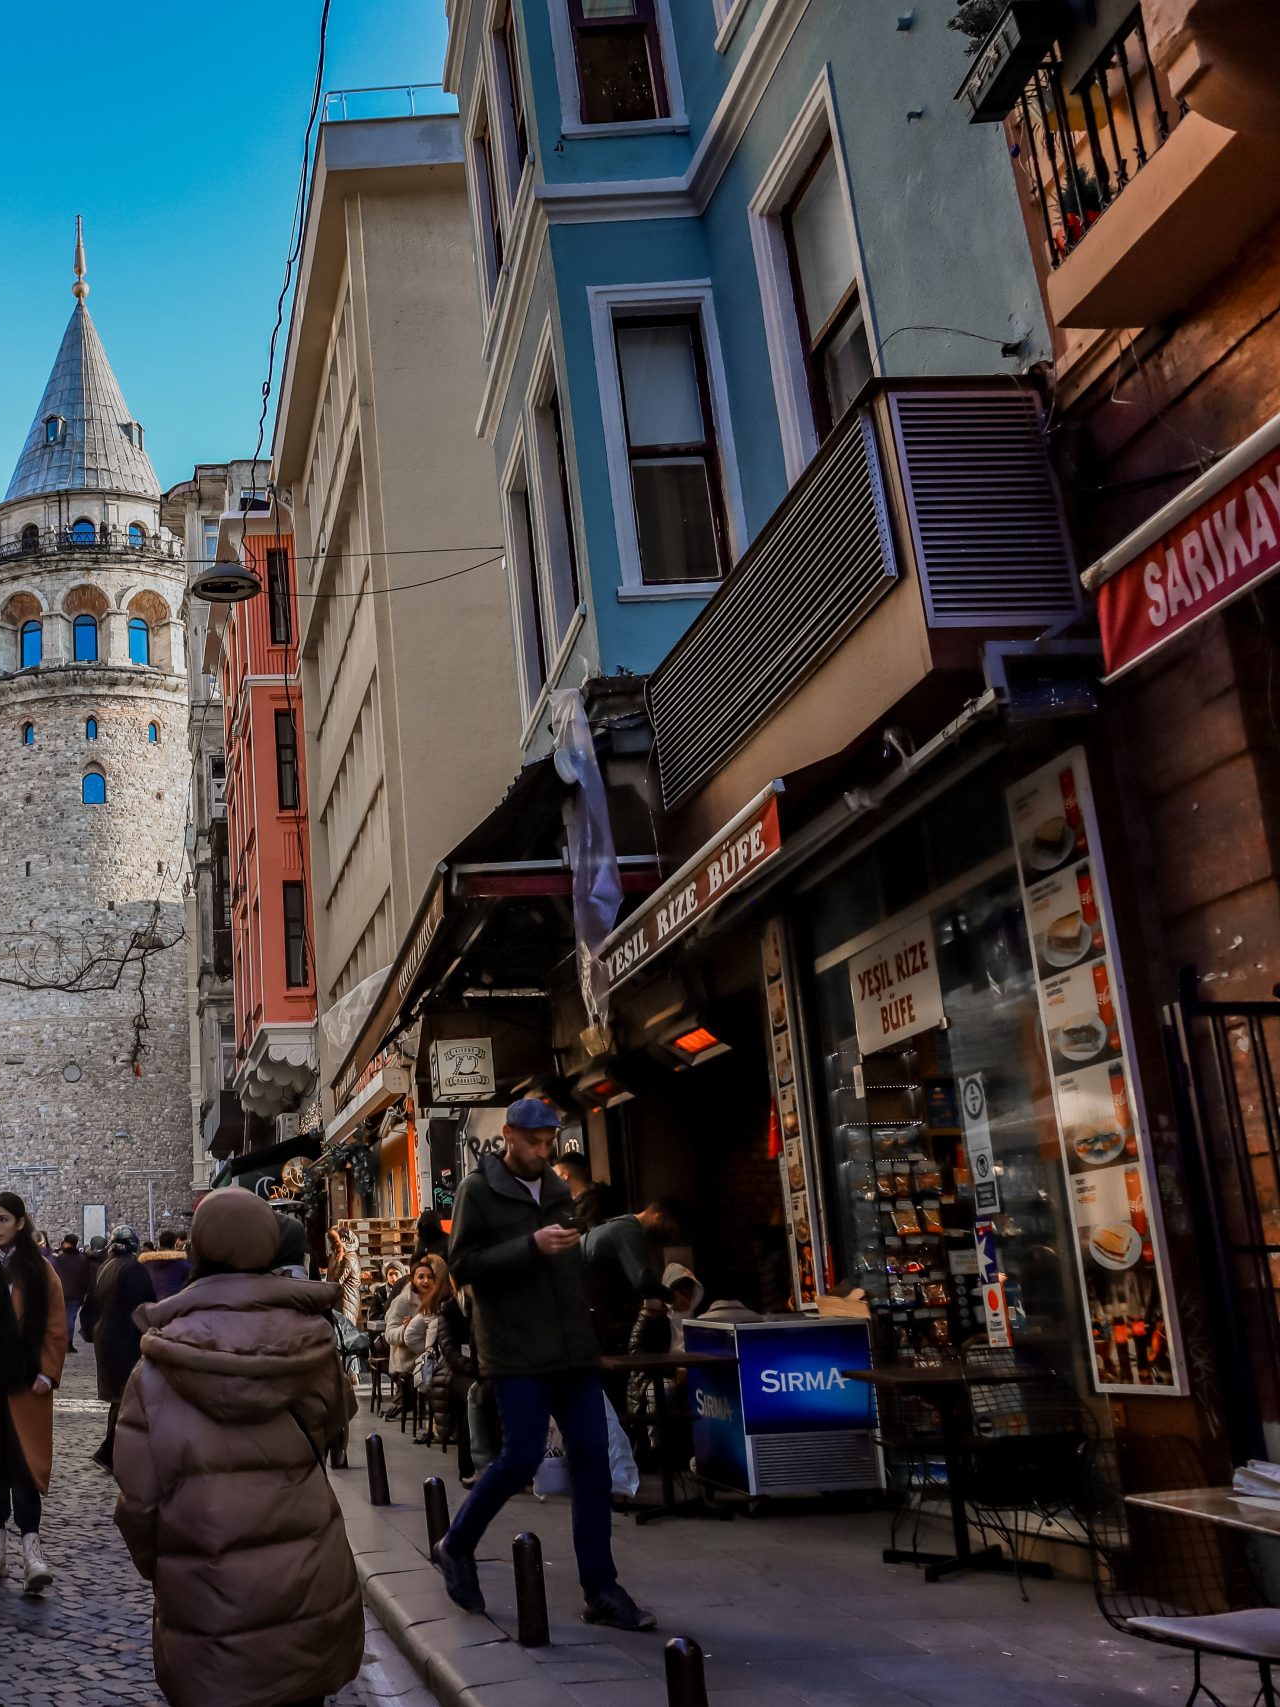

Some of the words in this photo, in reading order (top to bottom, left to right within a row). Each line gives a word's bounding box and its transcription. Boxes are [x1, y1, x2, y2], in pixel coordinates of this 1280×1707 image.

[706, 821, 765, 897] BÜFE
[857, 954, 893, 1002] YEŞİL
[894, 940, 928, 982] RİZE
[880, 992, 915, 1035] BÜFE
[760, 1367, 851, 1393] SIRMA
[695, 1388, 734, 1421] SIRMA
